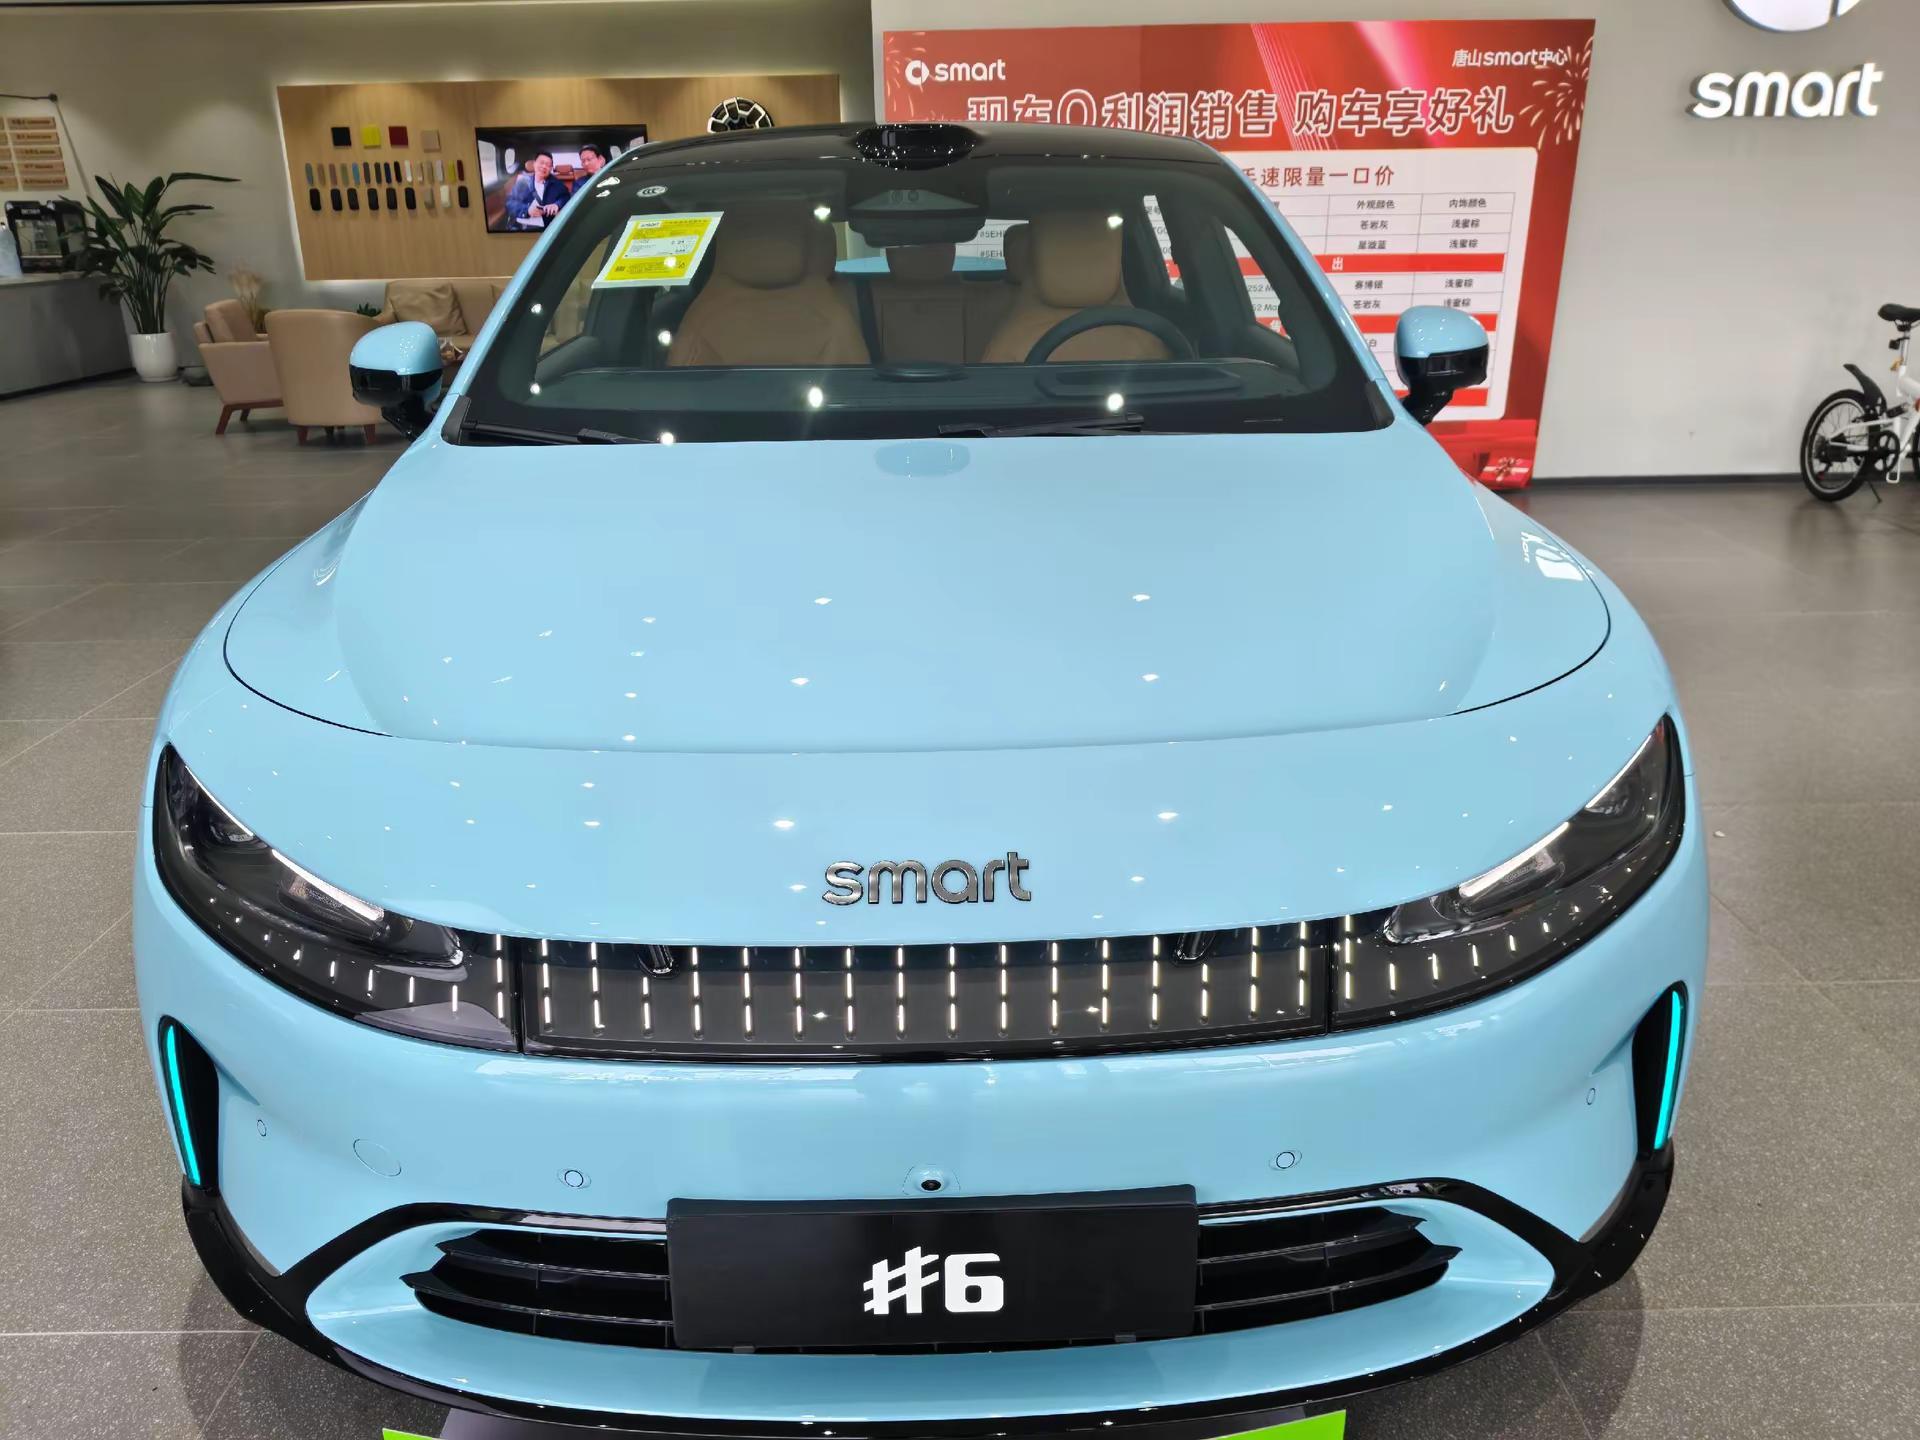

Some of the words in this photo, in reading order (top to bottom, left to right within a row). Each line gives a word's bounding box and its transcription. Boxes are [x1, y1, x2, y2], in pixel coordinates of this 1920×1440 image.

[1452, 48, 1568, 68] 唐山smart中心
[934, 59, 1006, 82] smart
[1691, 62, 1884, 119] smart
[1294, 86, 1514, 137] 购车享好礼
[1356, 199, 1395, 210] 外观颜色
[1448, 197, 1487, 208] 内饰颜色
[1360, 219, 1389, 230] 苍岩灰
[1451, 218, 1480, 229] 浅蜜棕
[1449, 238, 1478, 249] 浅蜜棕
[1331, 257, 1344, 272] 出
[1353, 300, 1381, 311] 苍岩灰
[822, 851, 1032, 906] smart
[863, 1246, 1004, 1315] #6
